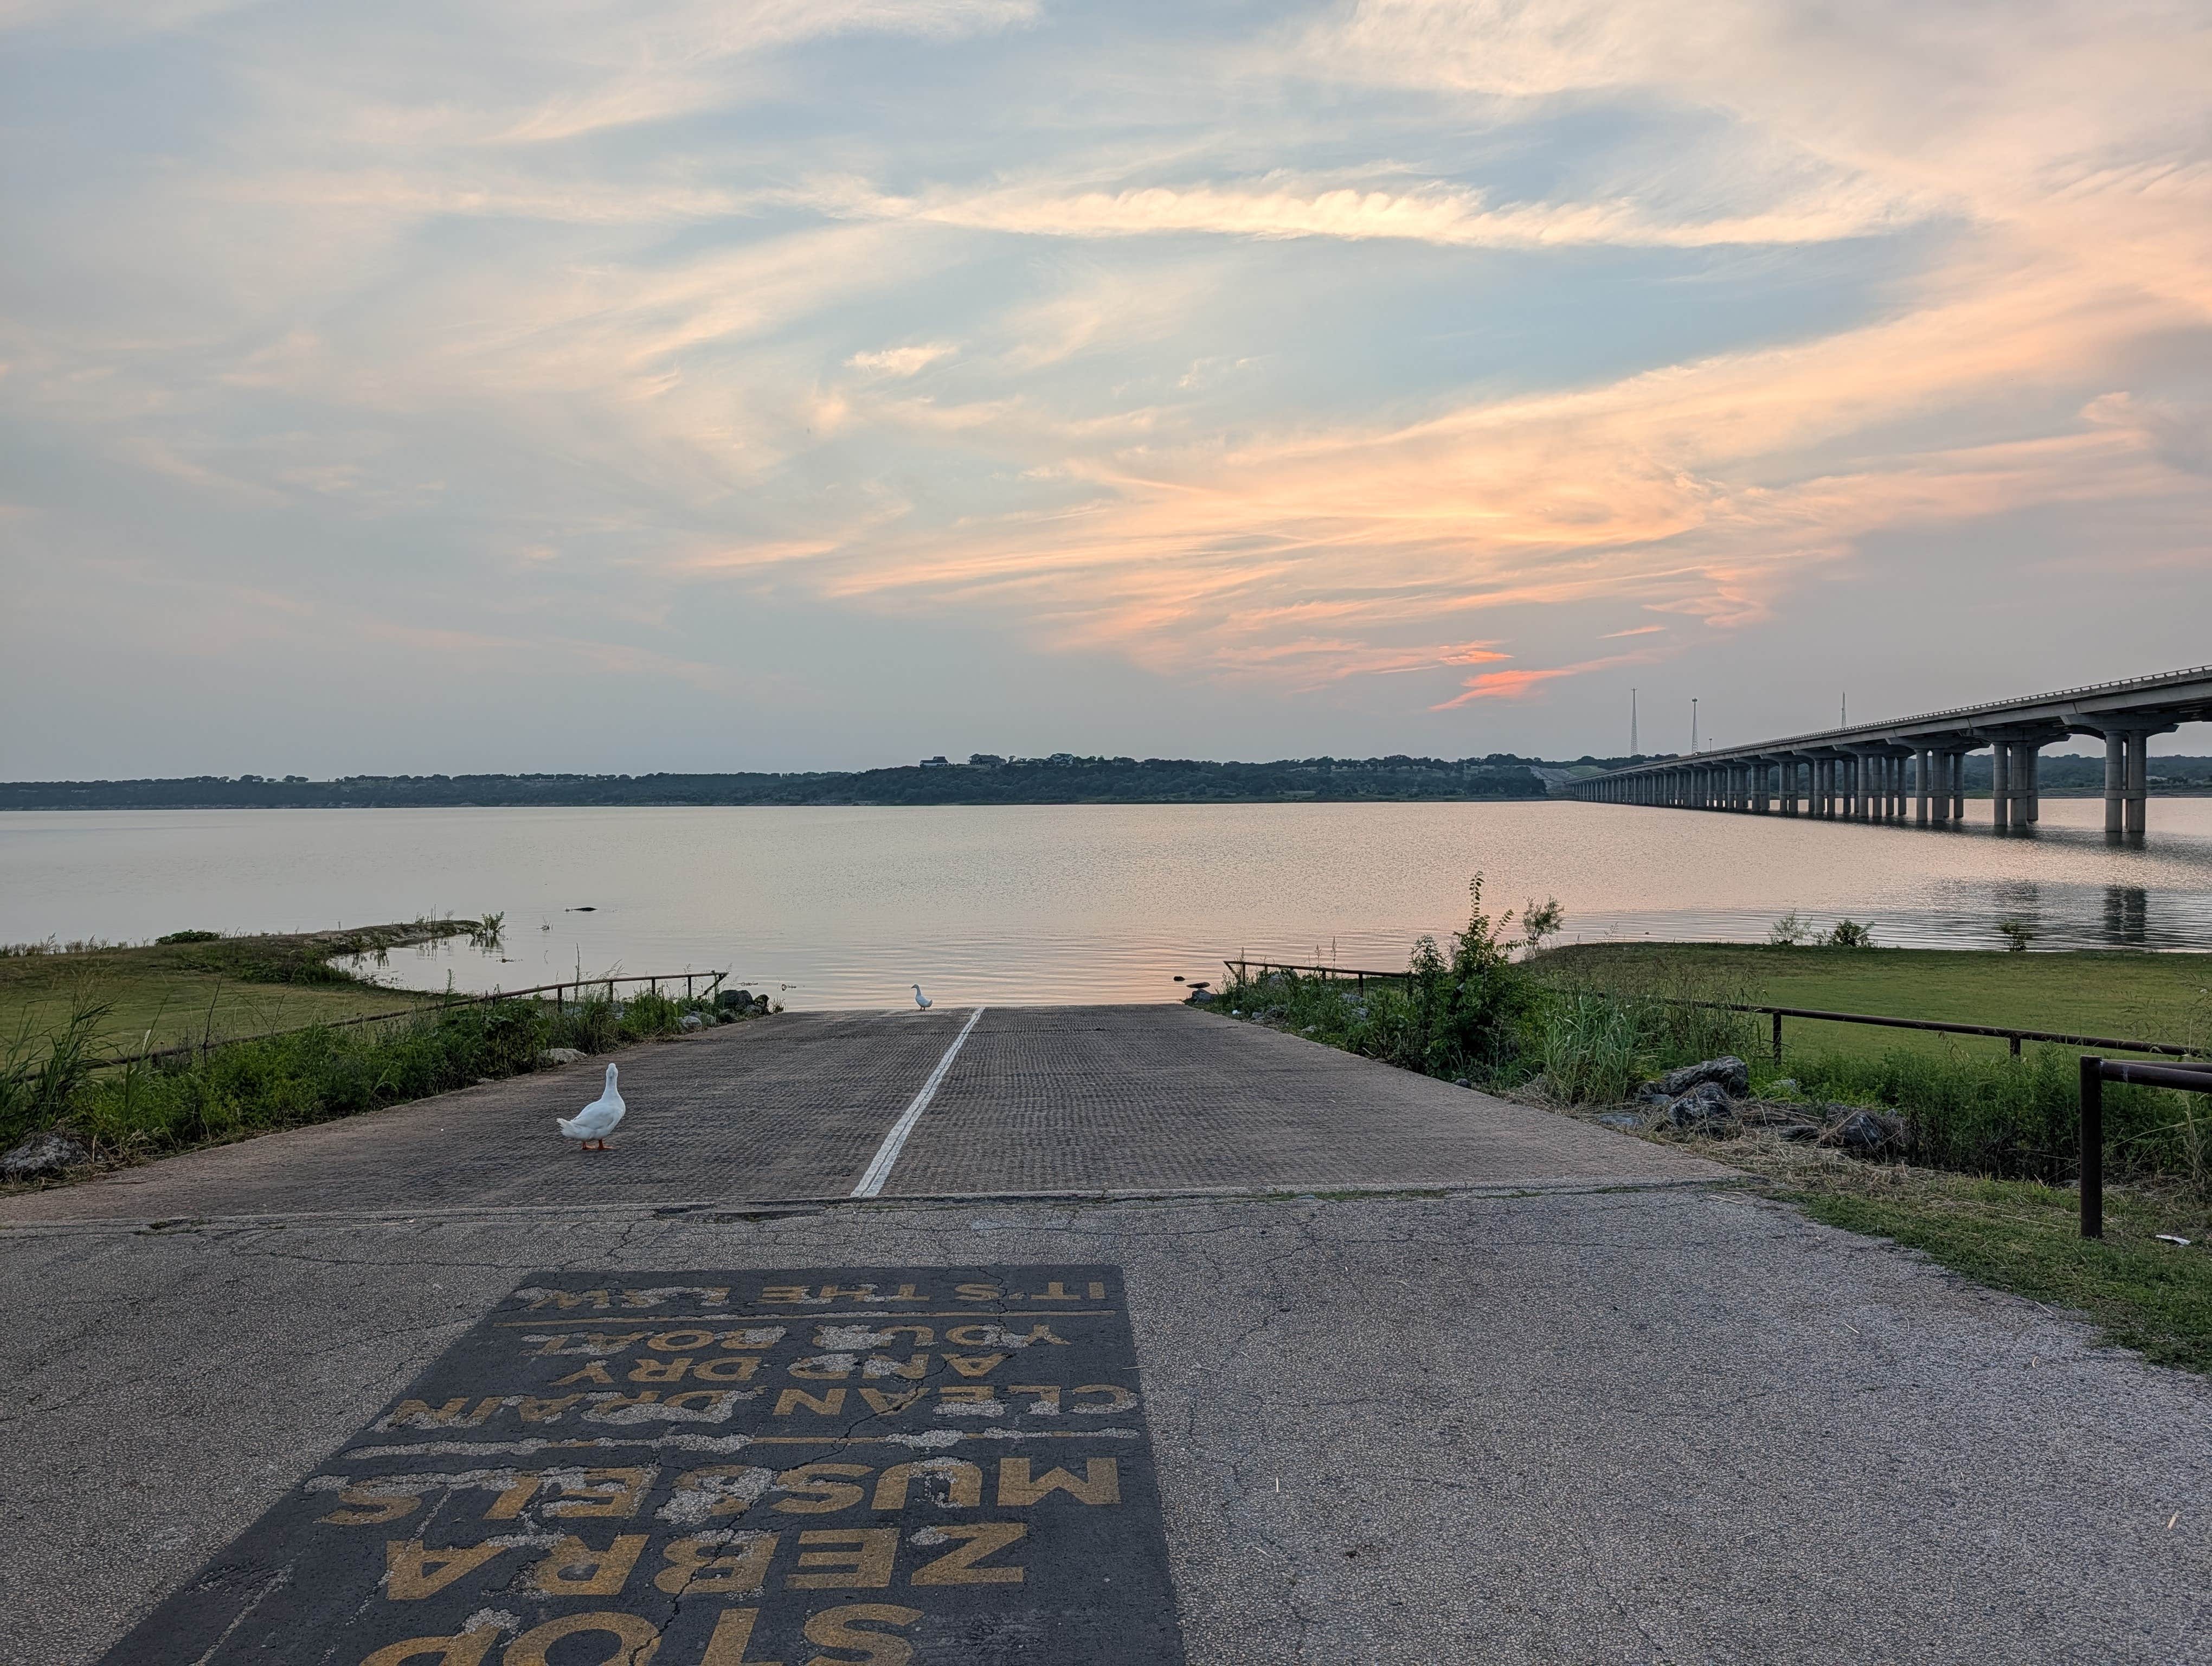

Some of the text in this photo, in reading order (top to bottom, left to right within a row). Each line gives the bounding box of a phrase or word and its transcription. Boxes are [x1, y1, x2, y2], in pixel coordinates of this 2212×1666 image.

[759, 1284, 930, 1304] THE
[955, 1281, 1105, 1300] IT'S
[518, 1324, 1072, 1356] YOUR BOAT
[547, 1353, 1009, 1386] AND DRY
[369, 1390, 755, 1432] DRAIN
[309, 1457, 1121, 1524] MUSSELS
[386, 1522, 1027, 1600] ZEBRA
[358, 1603, 923, 1666] STOP
